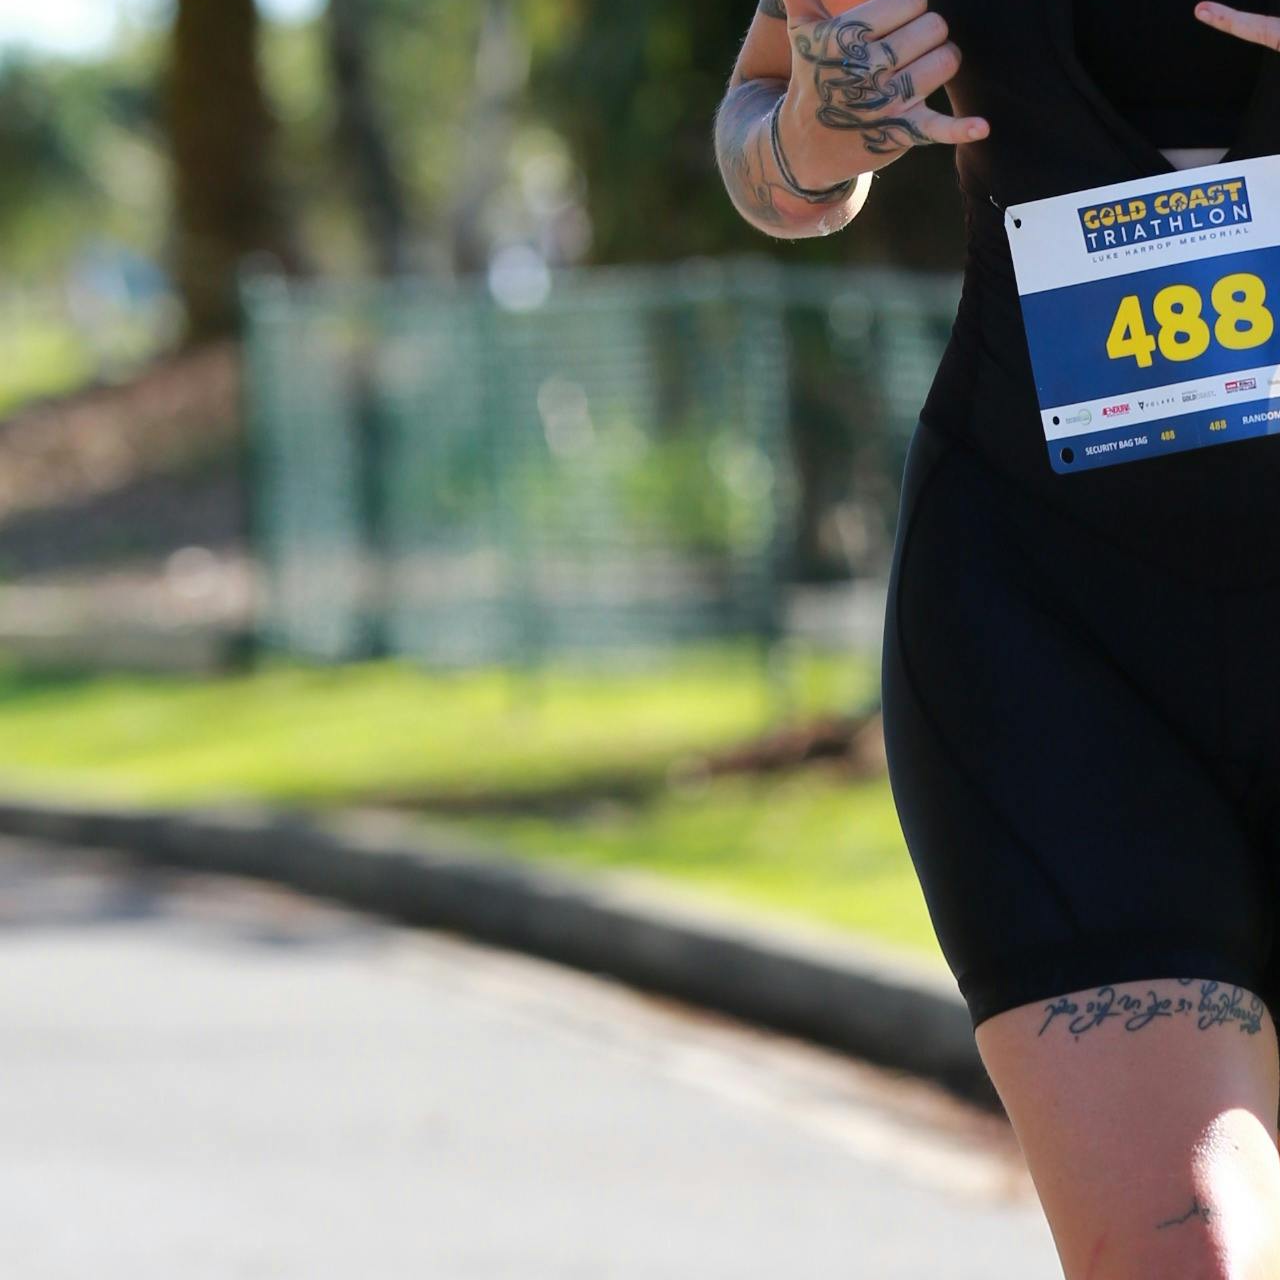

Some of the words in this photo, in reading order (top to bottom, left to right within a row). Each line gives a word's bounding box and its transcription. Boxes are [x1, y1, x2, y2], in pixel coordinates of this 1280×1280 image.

[1083, 200, 1147, 229] GOLD
[1154, 181, 1242, 216] COAST
[1087, 204, 1249, 249] TRIATHLON
[1092, 252, 1119, 263] LUKE
[1125, 241, 1172, 257] HARROP
[1179, 227, 1249, 245] MEMORIAL
[1105, 272, 1274, 368] 488
[1085, 441, 1118, 455] SECURITY
[1119, 438, 1134, 449] BAG
[1134, 436, 1148, 445] TAG
[1160, 430, 1176, 441] 488
[1209, 419, 1227, 431] 488
